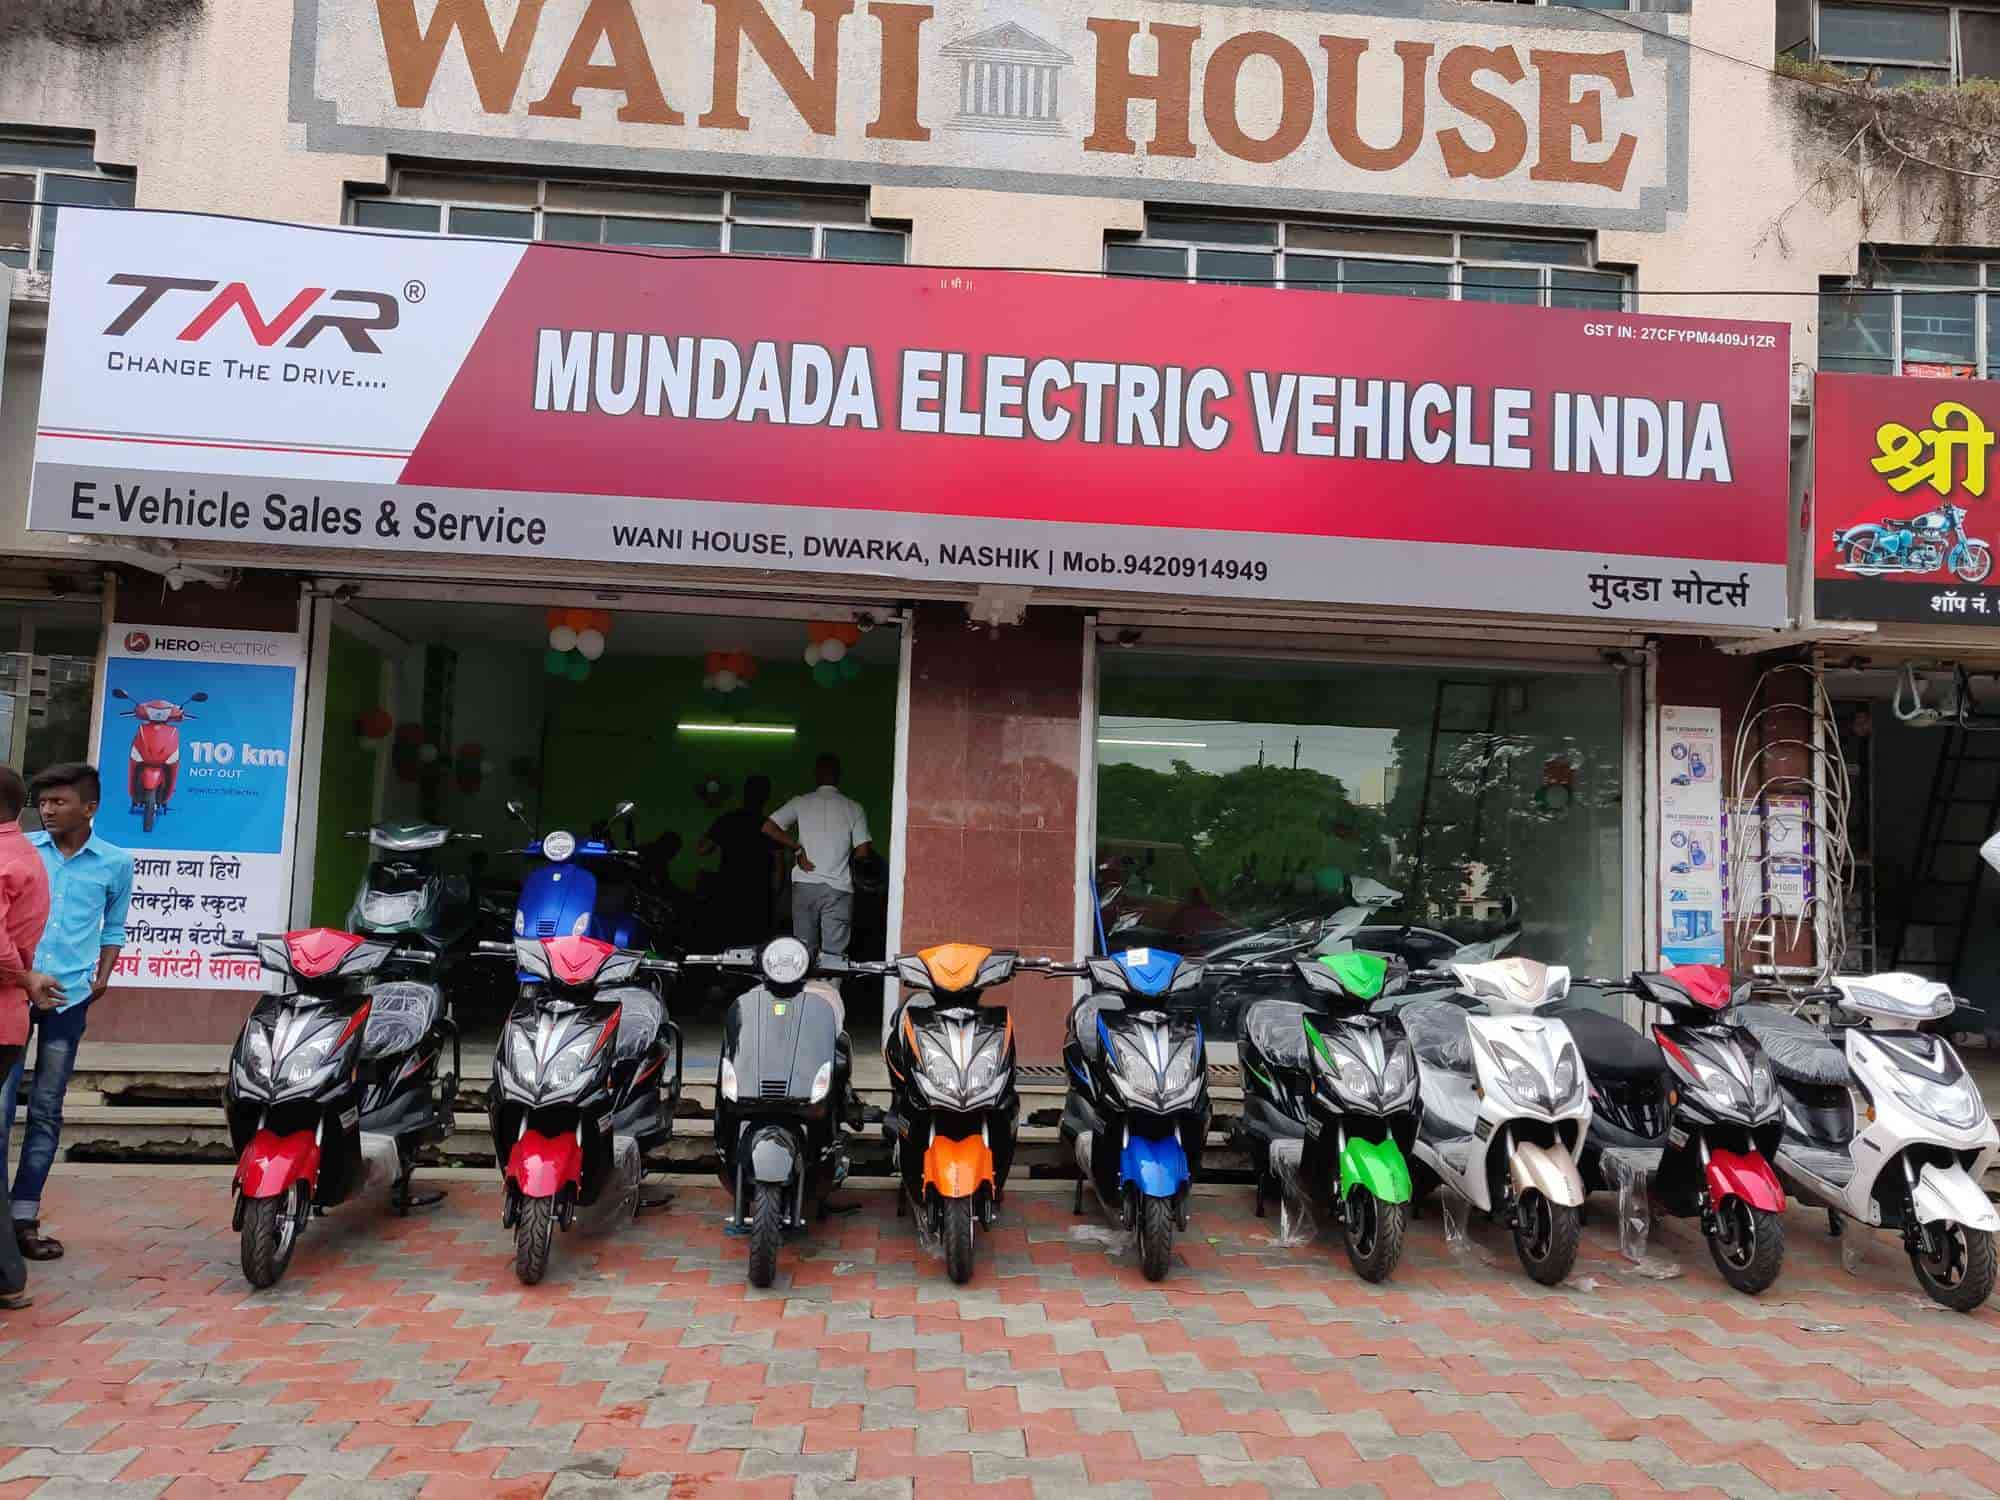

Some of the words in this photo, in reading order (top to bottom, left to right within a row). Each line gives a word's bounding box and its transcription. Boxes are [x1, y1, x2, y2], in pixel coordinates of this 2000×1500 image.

[374, 0, 935, 141] WANI
[1083, 16, 1634, 192] HOUSE
[103, 273, 400, 354] TNR
[1584, 324, 1613, 337] GST
[1618, 326, 1637, 339] IN:
[1641, 328, 1776, 348] 27CFYPM4409J1ZR
[223, 359, 271, 381] THE
[533, 328, 879, 430] MUNDADA
[899, 348, 1231, 452] ELECTRIC
[1248, 370, 1532, 470] VEHICLE
[1553, 391, 1733, 482] INDIA
[1871, 401, 1996, 496] श्री
[71, 481, 250, 529] E-Vehicle
[262, 494, 363, 536] Sales
[375, 501, 401, 537] &
[413, 501, 548, 546] Service
[612, 525, 683, 549] WANI
[691, 530, 794, 559] HOUSE,
[803, 536, 930, 566] DWARKA,
[939, 544, 1040, 569] NASHIK
[1063, 551, 1268, 581] Mob.9420914949
[1587, 564, 1663, 609] मुंदडा
[1671, 570, 1751, 607] मोटर्स
[1930, 590, 1968, 612] शॉप
[189, 767, 214, 777] NOT
[217, 768, 242, 780] OUT
[190, 741, 234, 765] 110
[242, 744, 287, 767] km
[130, 885, 195, 916] लेक्ट्रीक
